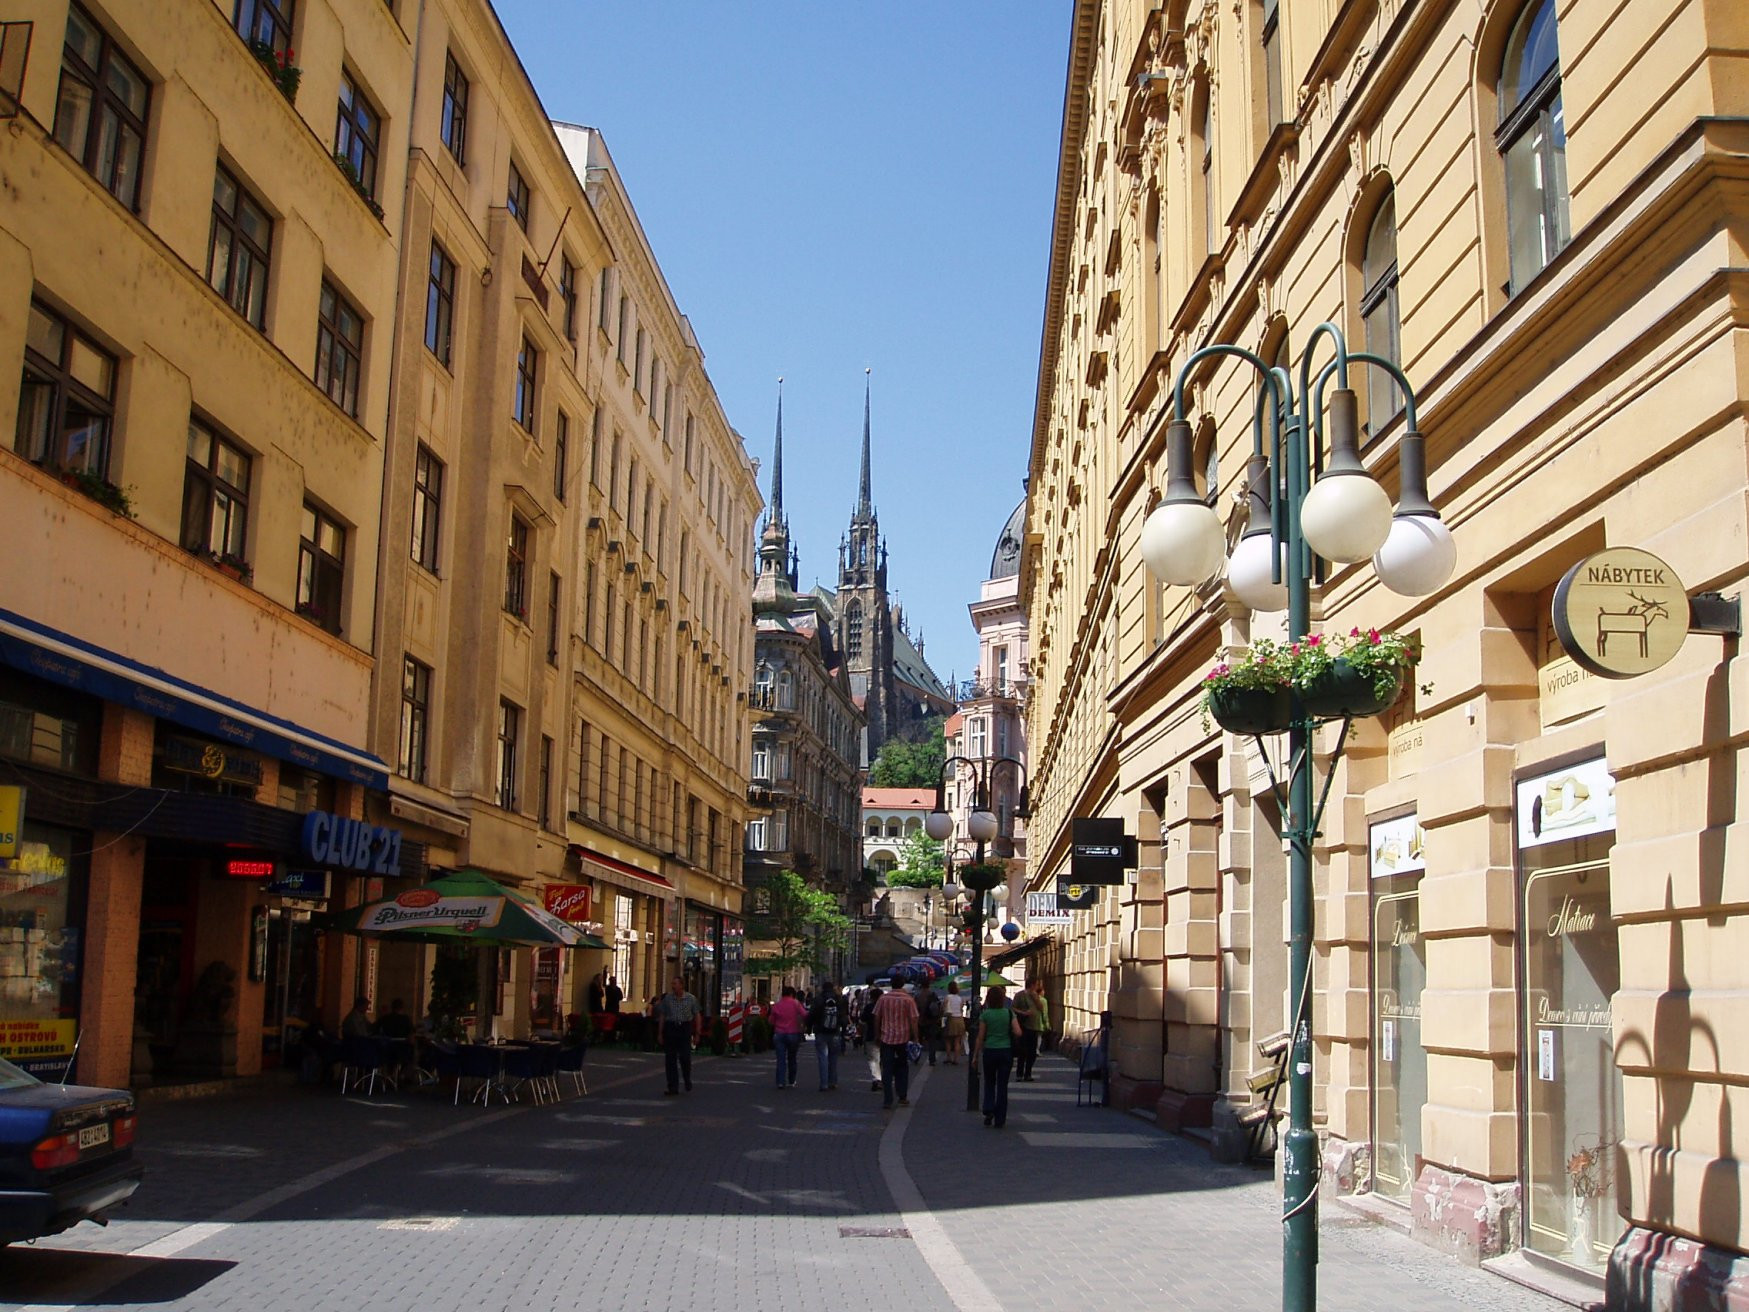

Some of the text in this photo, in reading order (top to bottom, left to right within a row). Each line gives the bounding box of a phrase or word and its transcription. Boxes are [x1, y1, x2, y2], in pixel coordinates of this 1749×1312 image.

[1588, 563, 1665, 584] NÁBYTEK
[1547, 669, 1579, 695] výroba
[311, 811, 403, 877] CLUB 21
[374, 906, 432, 925] Pilsner
[433, 905, 487, 919] Urquell
[1029, 909, 1071, 918] DEMIX
[1547, 893, 1596, 937] Matrace
[10, 1029, 57, 1043] OSTROVŮ
